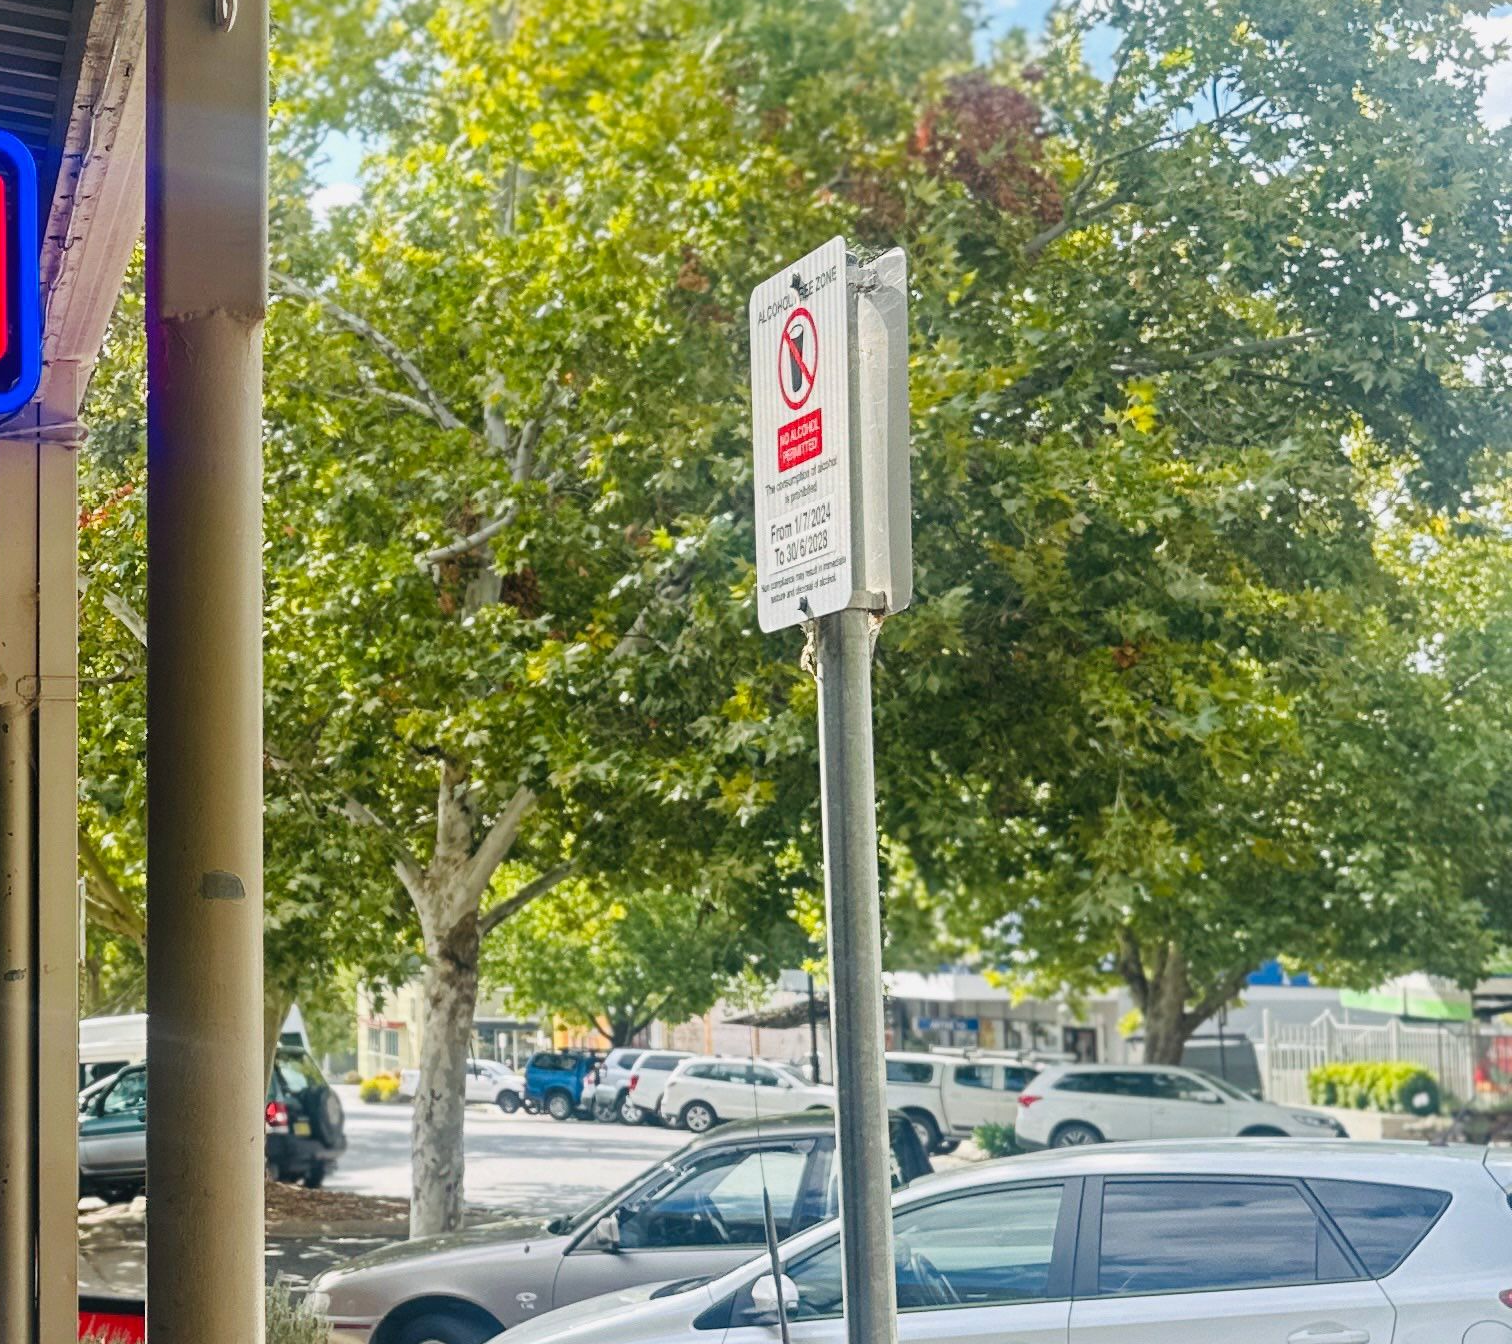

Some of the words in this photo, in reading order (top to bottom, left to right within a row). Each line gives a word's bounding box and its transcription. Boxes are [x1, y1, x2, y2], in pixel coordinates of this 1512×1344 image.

[758, 295, 793, 325] ALCOHOL
[815, 265, 837, 292] ZONE
[770, 523, 792, 544] From
[794, 502, 831, 533] 1/7/2024
[775, 548, 785, 566] To
